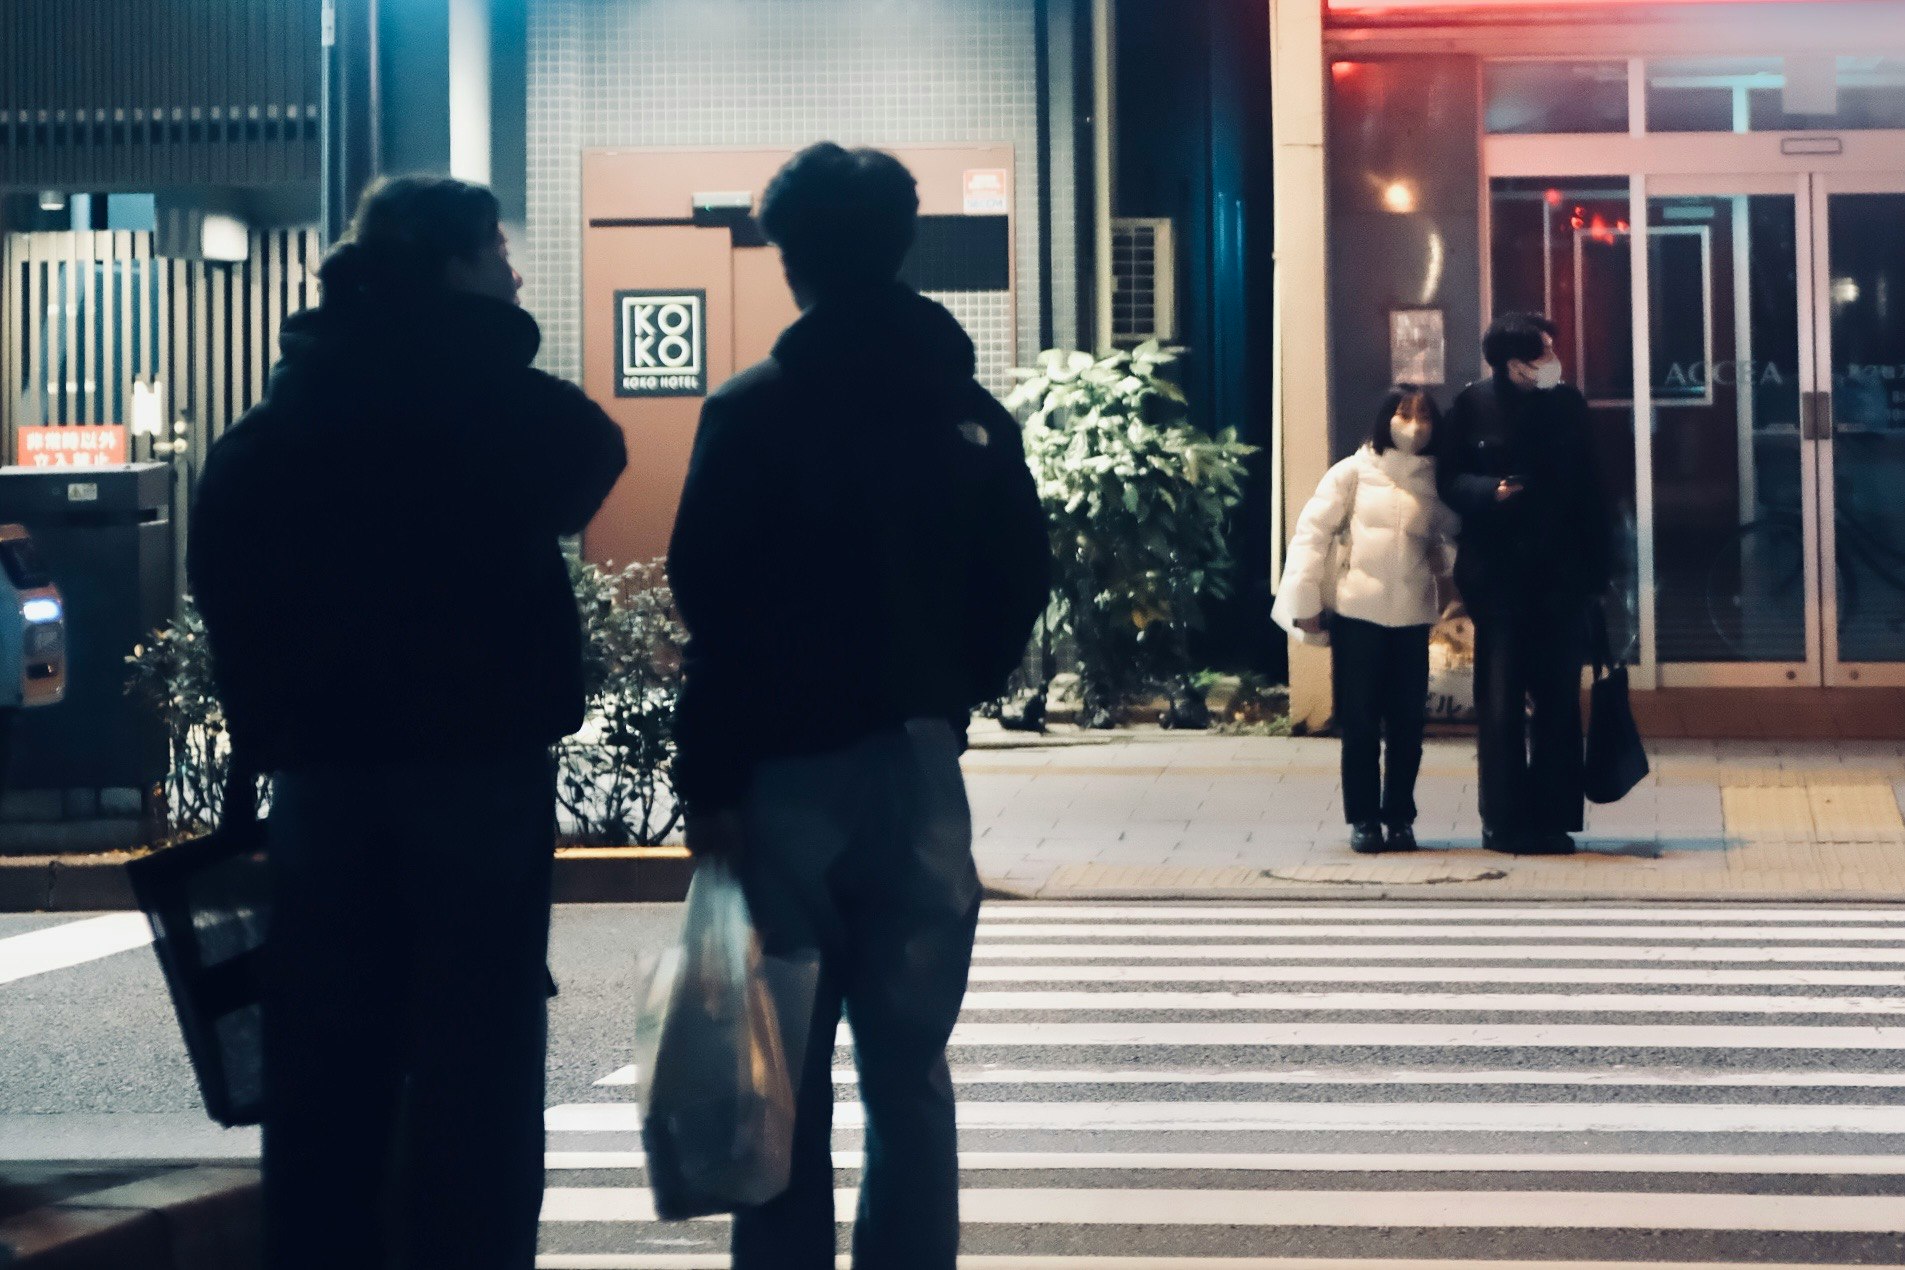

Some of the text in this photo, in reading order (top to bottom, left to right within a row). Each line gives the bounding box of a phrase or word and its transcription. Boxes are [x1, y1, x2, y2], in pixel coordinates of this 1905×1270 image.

[634, 303, 691, 335] KO
[634, 335, 691, 367] KO
[622, 375, 699, 390] KOKO HOTEL
